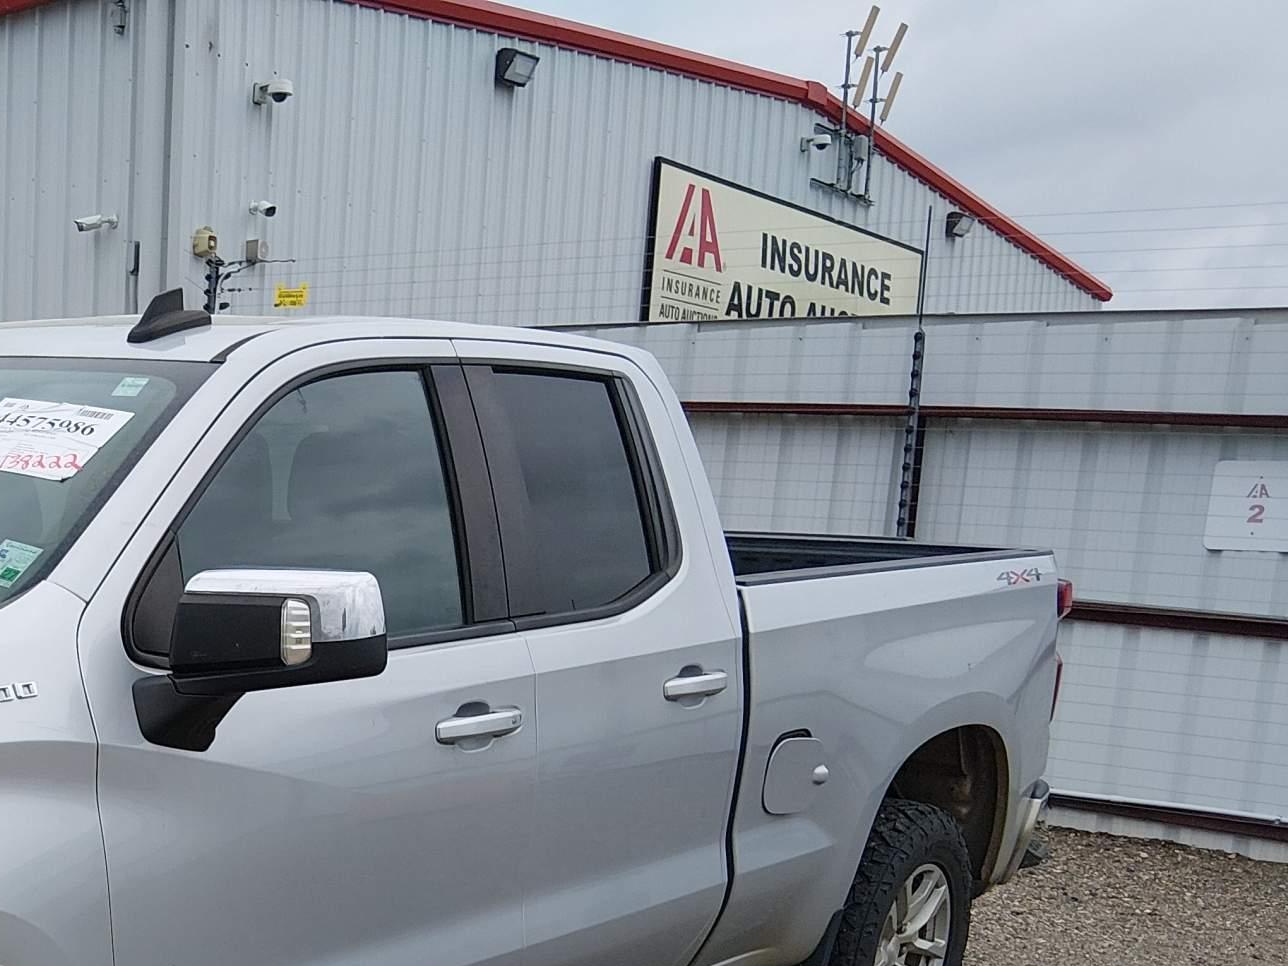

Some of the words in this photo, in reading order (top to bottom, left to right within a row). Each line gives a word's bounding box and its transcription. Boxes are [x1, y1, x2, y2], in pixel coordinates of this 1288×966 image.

[761, 232, 892, 305] INSURANCE
[661, 277, 721, 304] INSURANCE
[725, 280, 796, 318] AUTO
[659, 303, 680, 320] AUTO
[1246, 505, 1266, 523] 2
